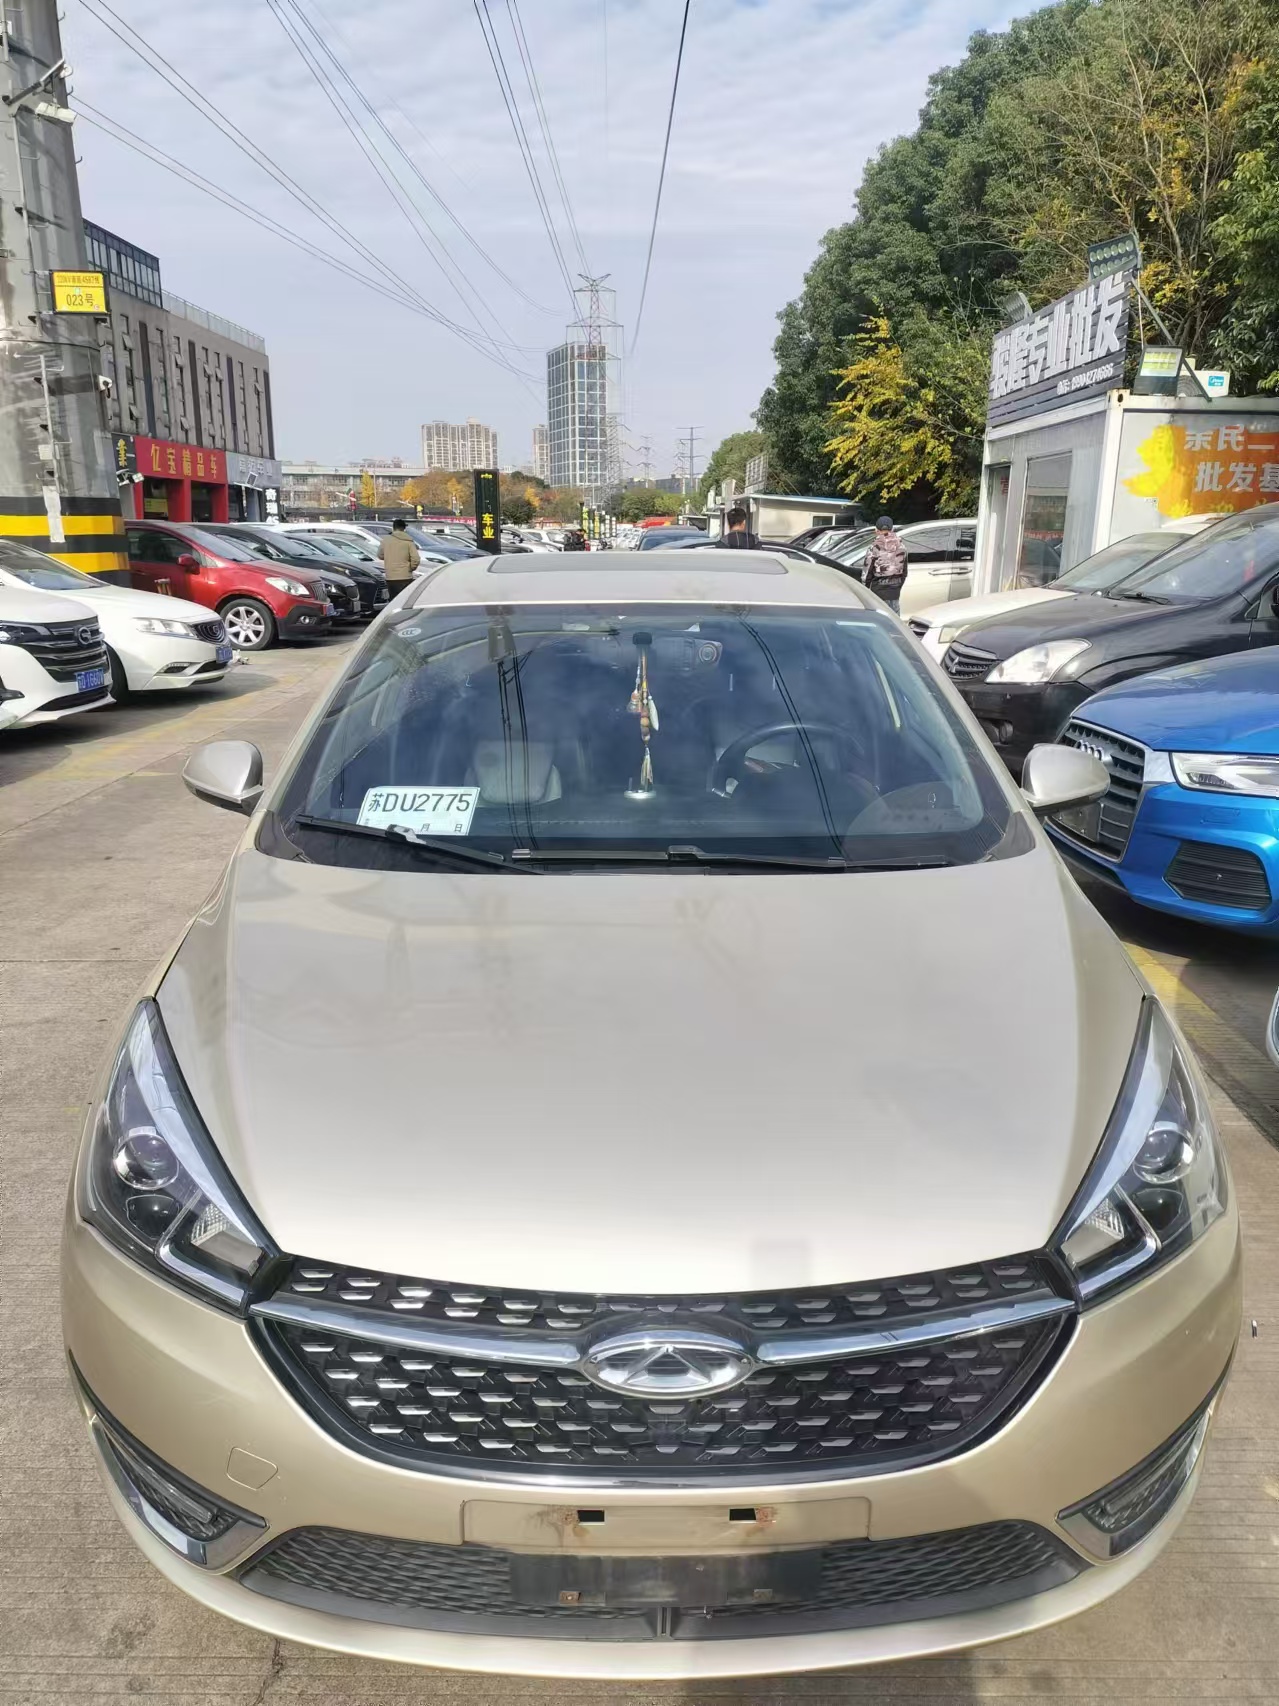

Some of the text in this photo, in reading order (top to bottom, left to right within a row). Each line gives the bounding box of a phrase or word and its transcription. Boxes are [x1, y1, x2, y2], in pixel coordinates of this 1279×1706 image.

[66, 293, 94, 307] 023号
[150, 443, 218, 480] 亿宝精品车
[368, 793, 472, 812] 苏DU2775
